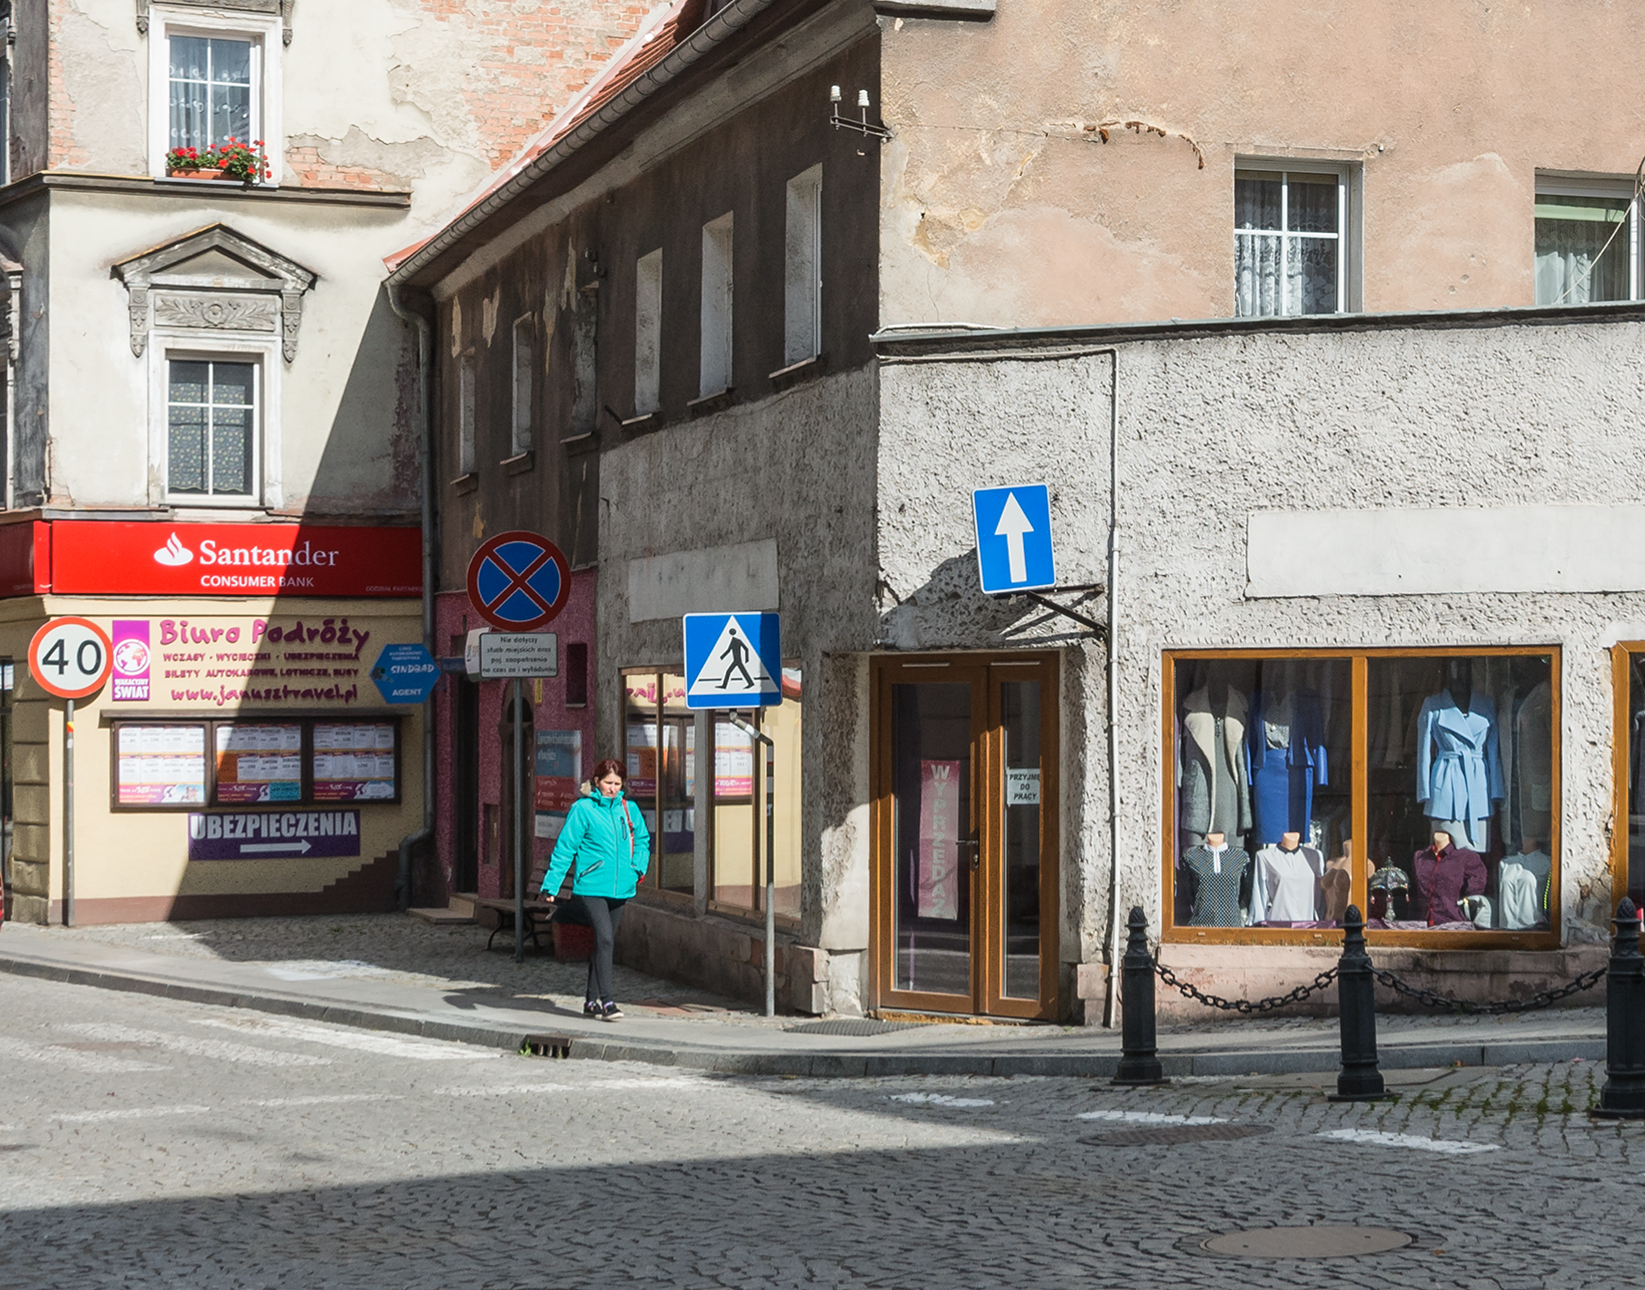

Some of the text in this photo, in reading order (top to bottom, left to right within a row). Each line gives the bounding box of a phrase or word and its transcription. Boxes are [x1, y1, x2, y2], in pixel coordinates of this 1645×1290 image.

[200, 539, 339, 566] Santander
[200, 575, 314, 588] CONSUMER BANK
[160, 618, 370, 652] Biuro Podróży
[513, 636, 538, 644] dotyczy
[41, 638, 102, 675] 40
[163, 653, 206, 661] WCZASY
[216, 653, 271, 662] WYCIECZKI
[165, 669, 200, 678] BILETY
[333, 668, 359, 677] BUSY
[390, 664, 435, 674] SINDBAD
[171, 683, 358, 706] www.janusztravel.pl
[392, 688, 422, 696] AGENT
[190, 812, 358, 840] UBEZPIECZENIA
